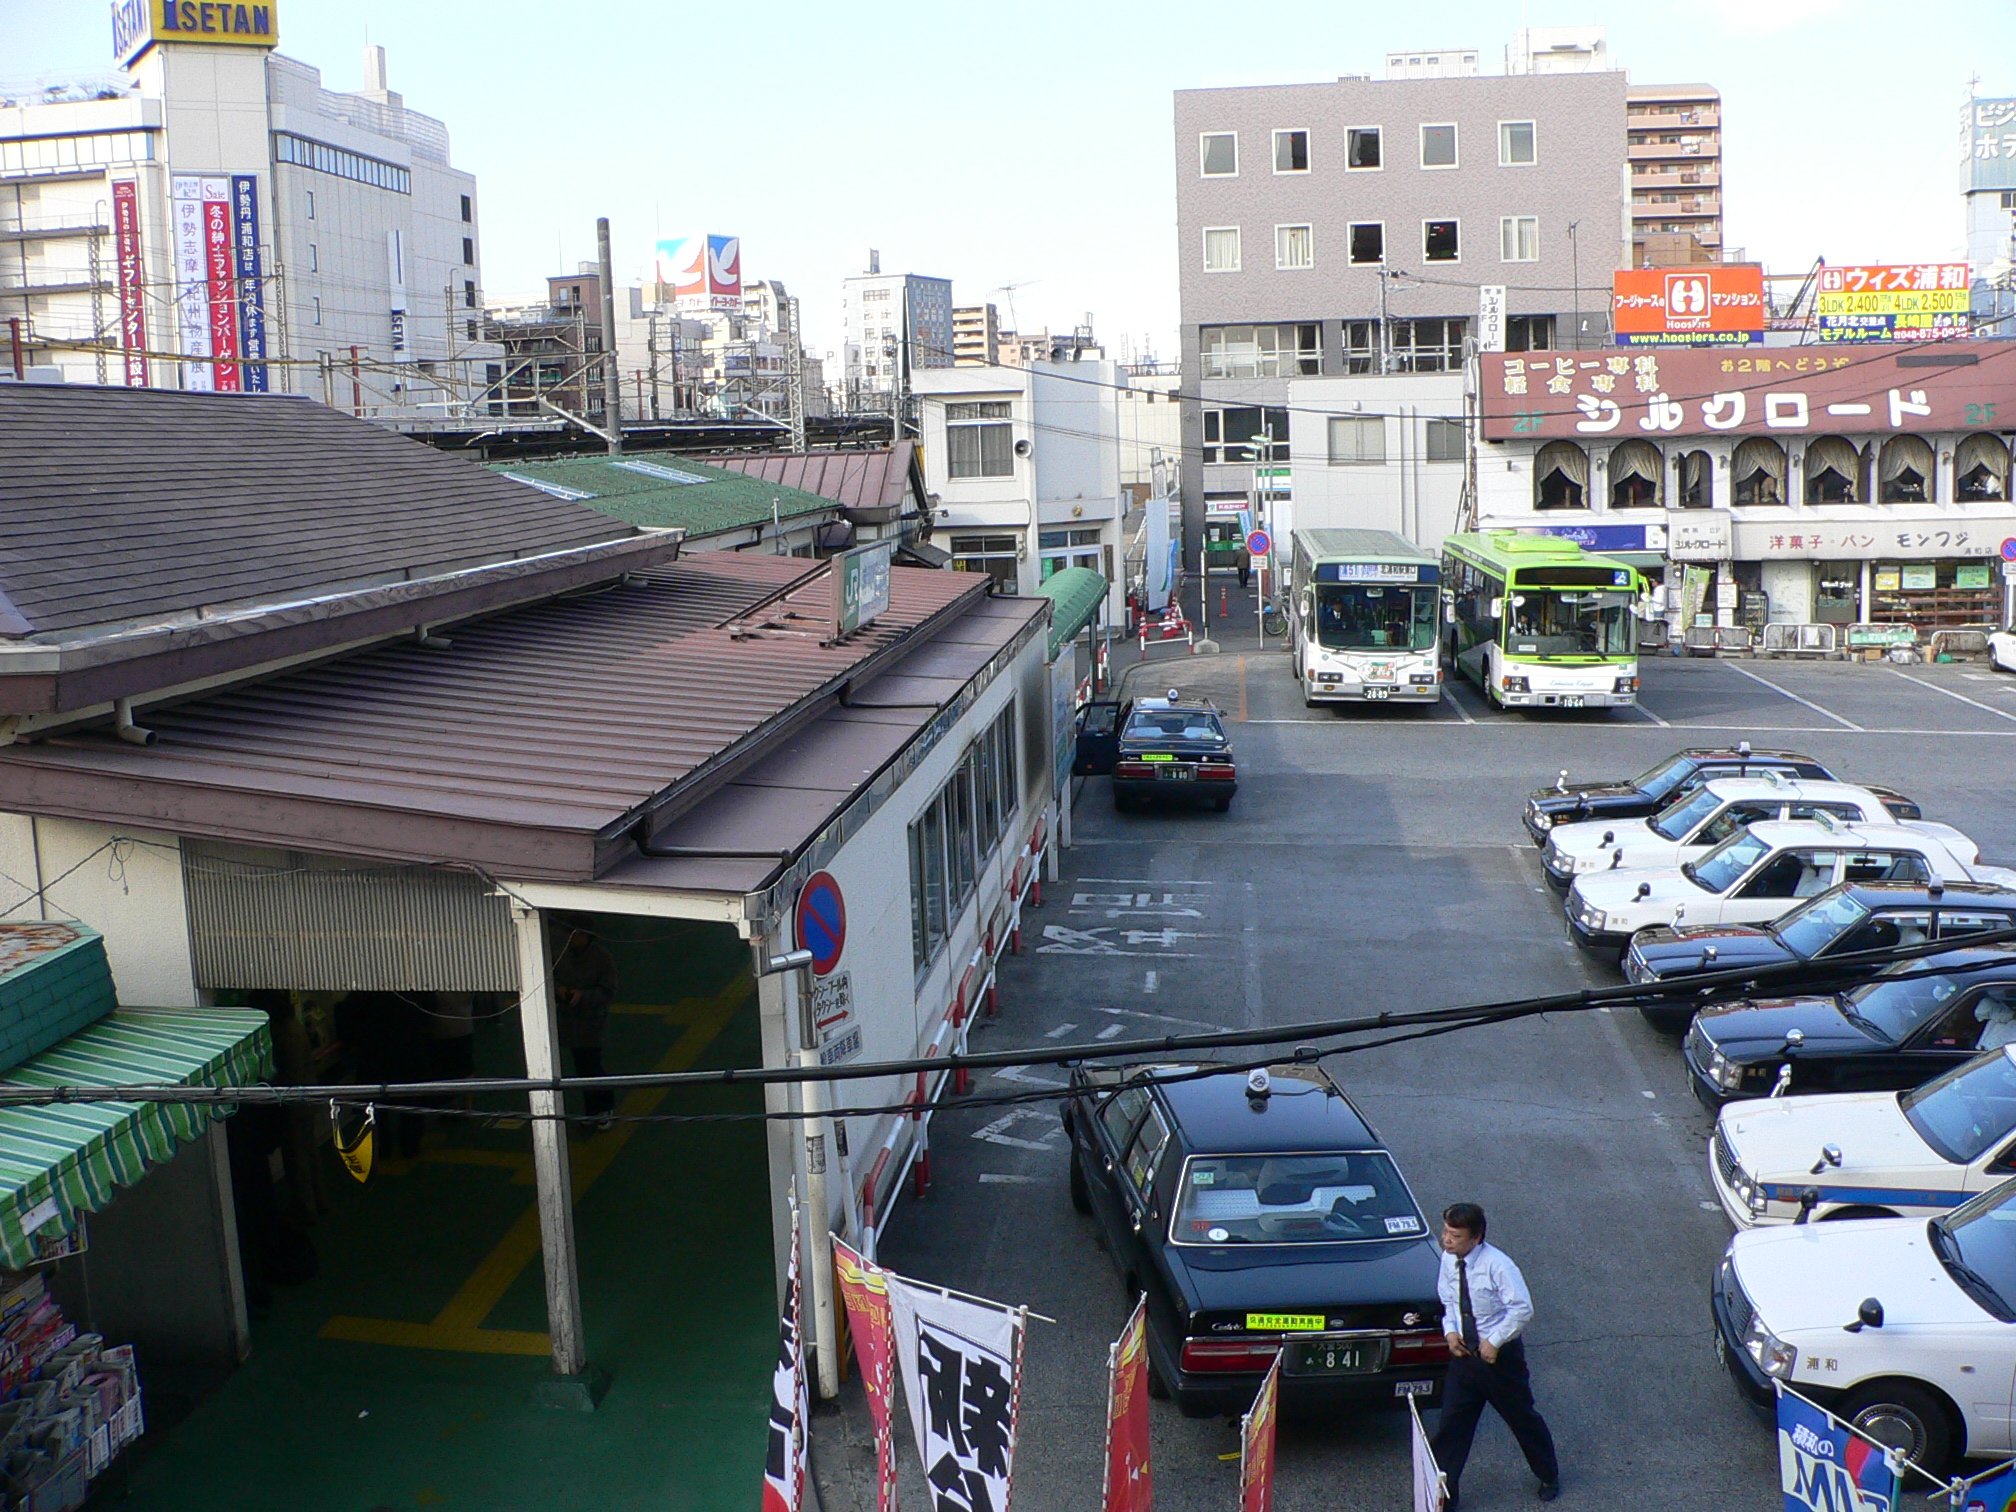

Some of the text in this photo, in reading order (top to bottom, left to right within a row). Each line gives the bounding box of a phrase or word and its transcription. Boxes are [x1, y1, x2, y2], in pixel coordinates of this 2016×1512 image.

[161, 0, 270, 34] ISETAN
[204, 183, 226, 200] Sale
[1846, 265, 1966, 291] ウィズ浦和
[1819, 296, 1845, 313] 3LDK
[1894, 295, 1920, 311] 4LDK
[1629, 331, 1750, 344] www.hoosiers.co.jp
[1820, 328, 1892, 341] モデルルーム
[1576, 389, 1932, 433] シルクロード
[1964, 402, 1999, 424] 2F
[1512, 410, 1546, 433] 2F
[845, 568, 859, 605] JR
[1806, 1357, 1838, 1371] 浦和
